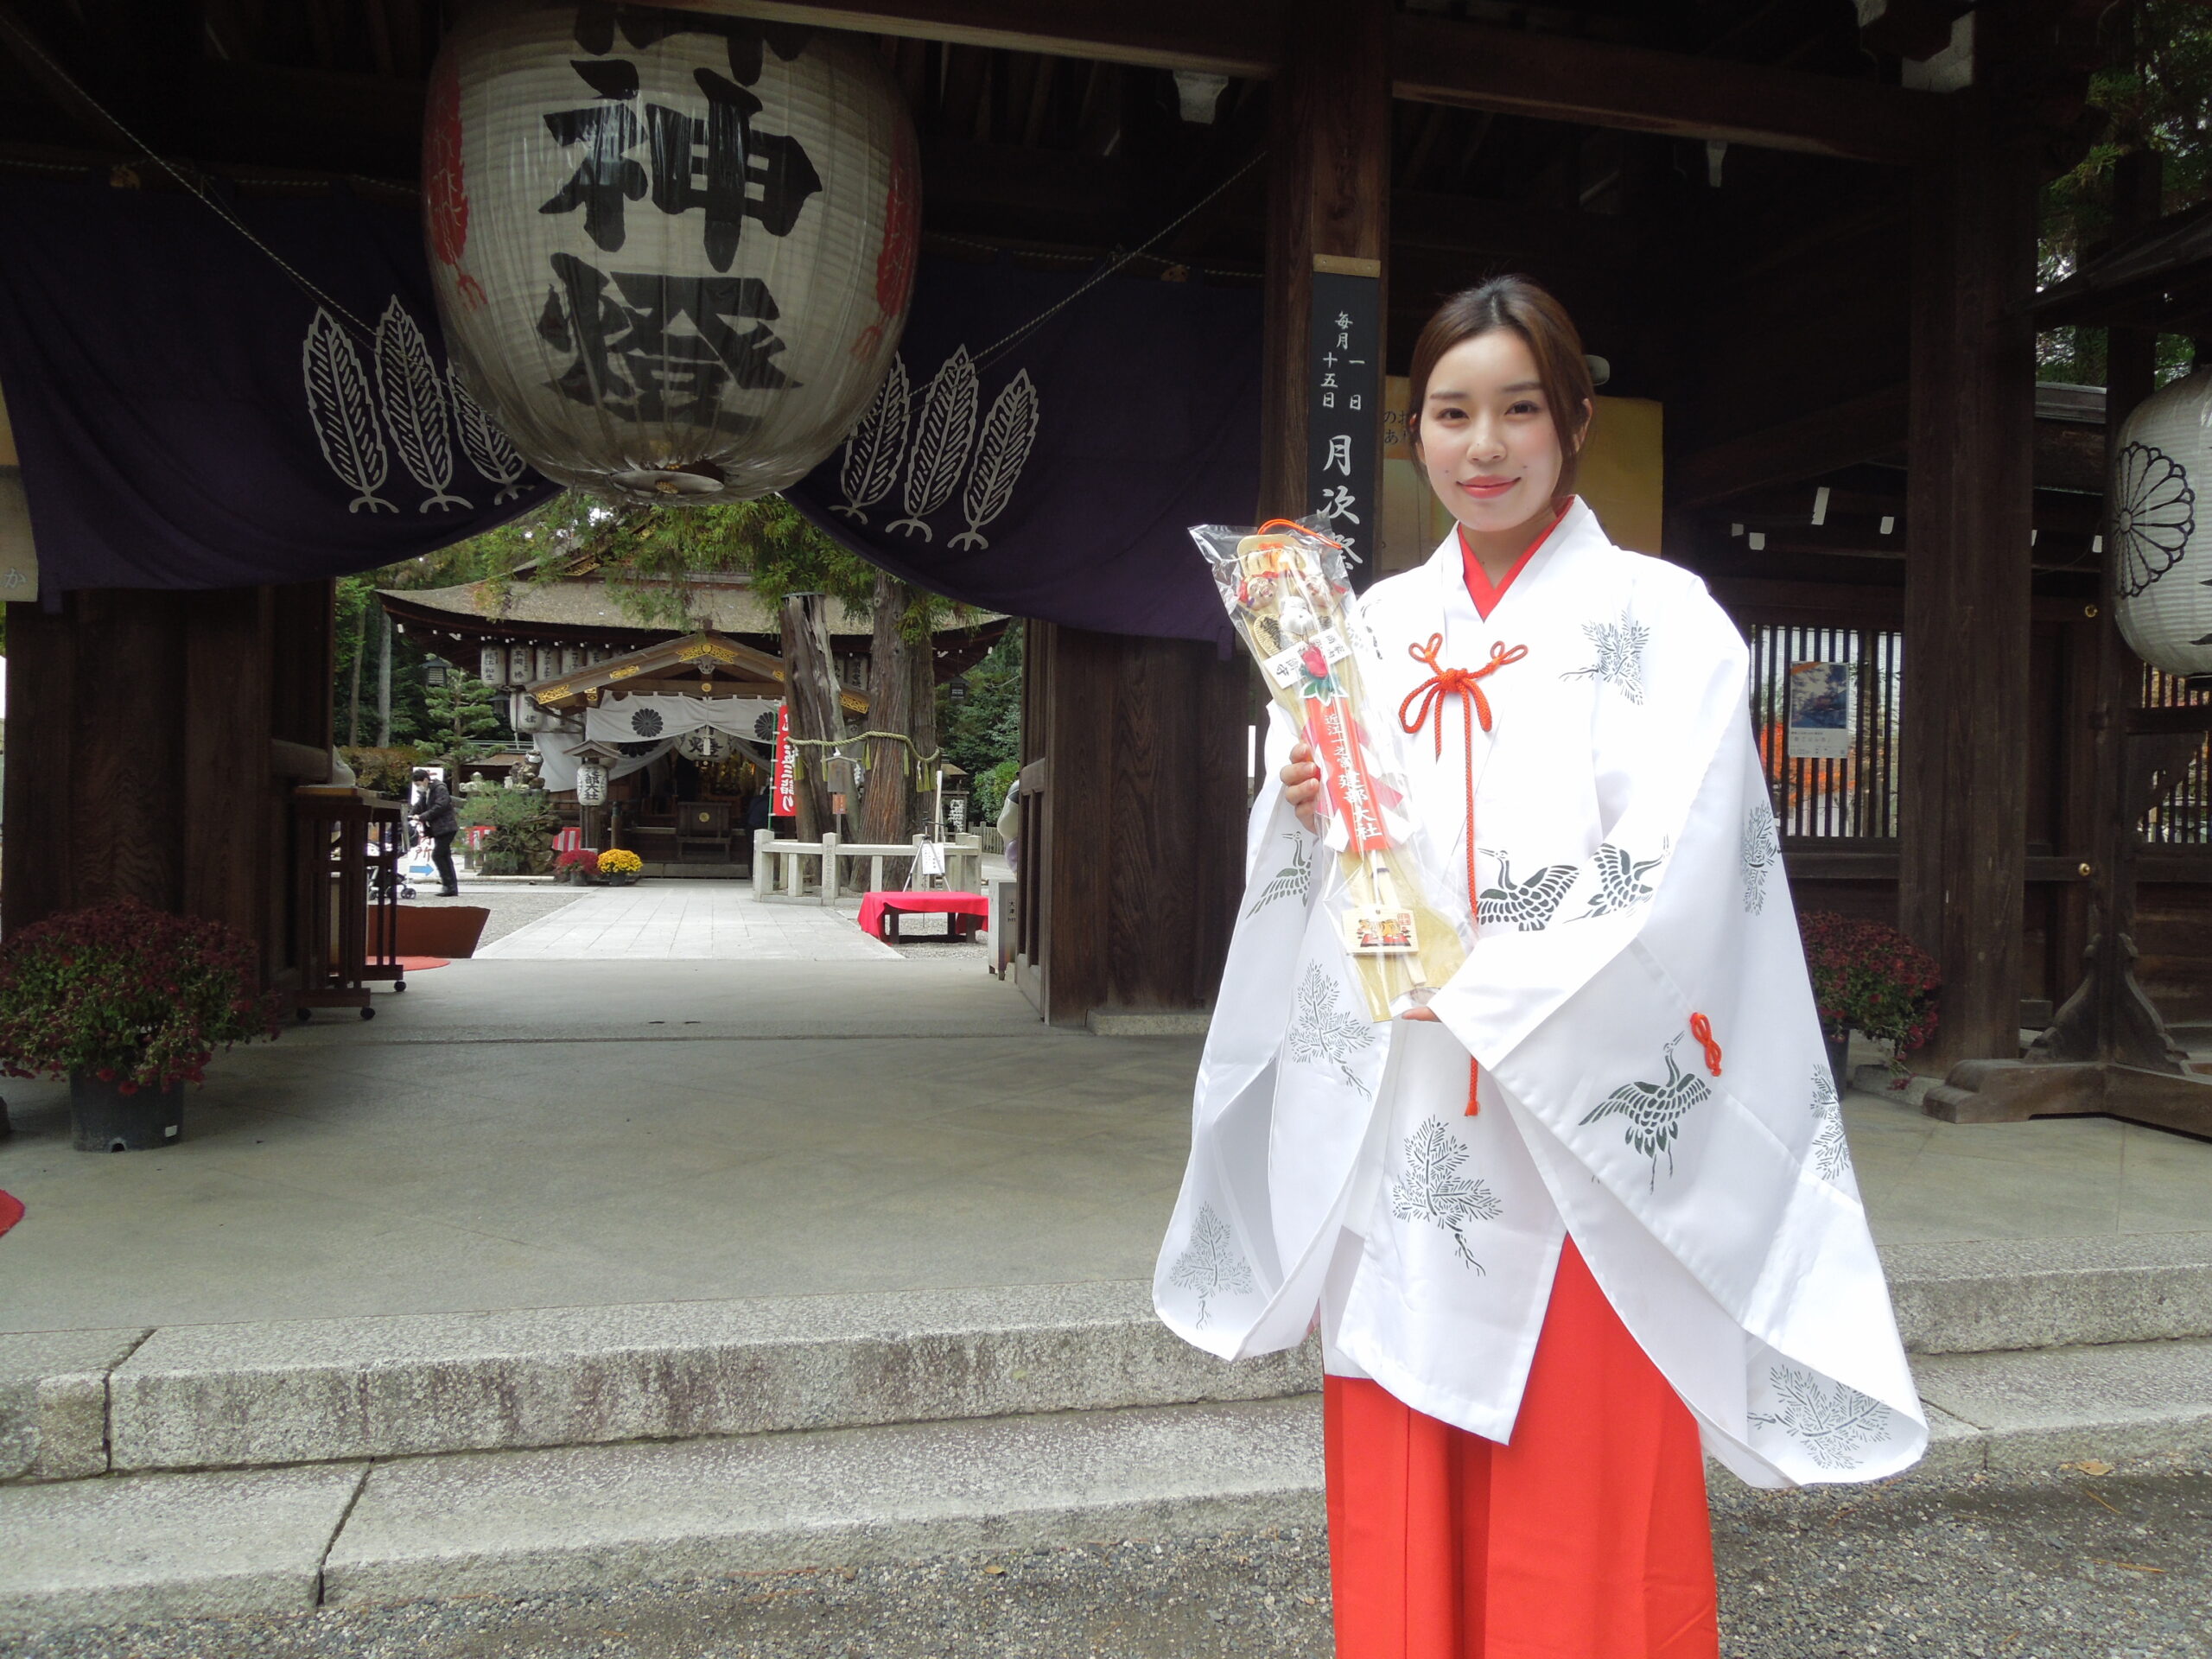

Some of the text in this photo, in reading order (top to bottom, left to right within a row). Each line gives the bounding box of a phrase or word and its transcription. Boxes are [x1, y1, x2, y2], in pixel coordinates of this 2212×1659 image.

[537, 14, 822, 430] 神燈
[1335, 311, 1353, 349] 毎月
[1320, 352, 1338, 410] 十五日
[1348, 358, 1365, 410] 一日
